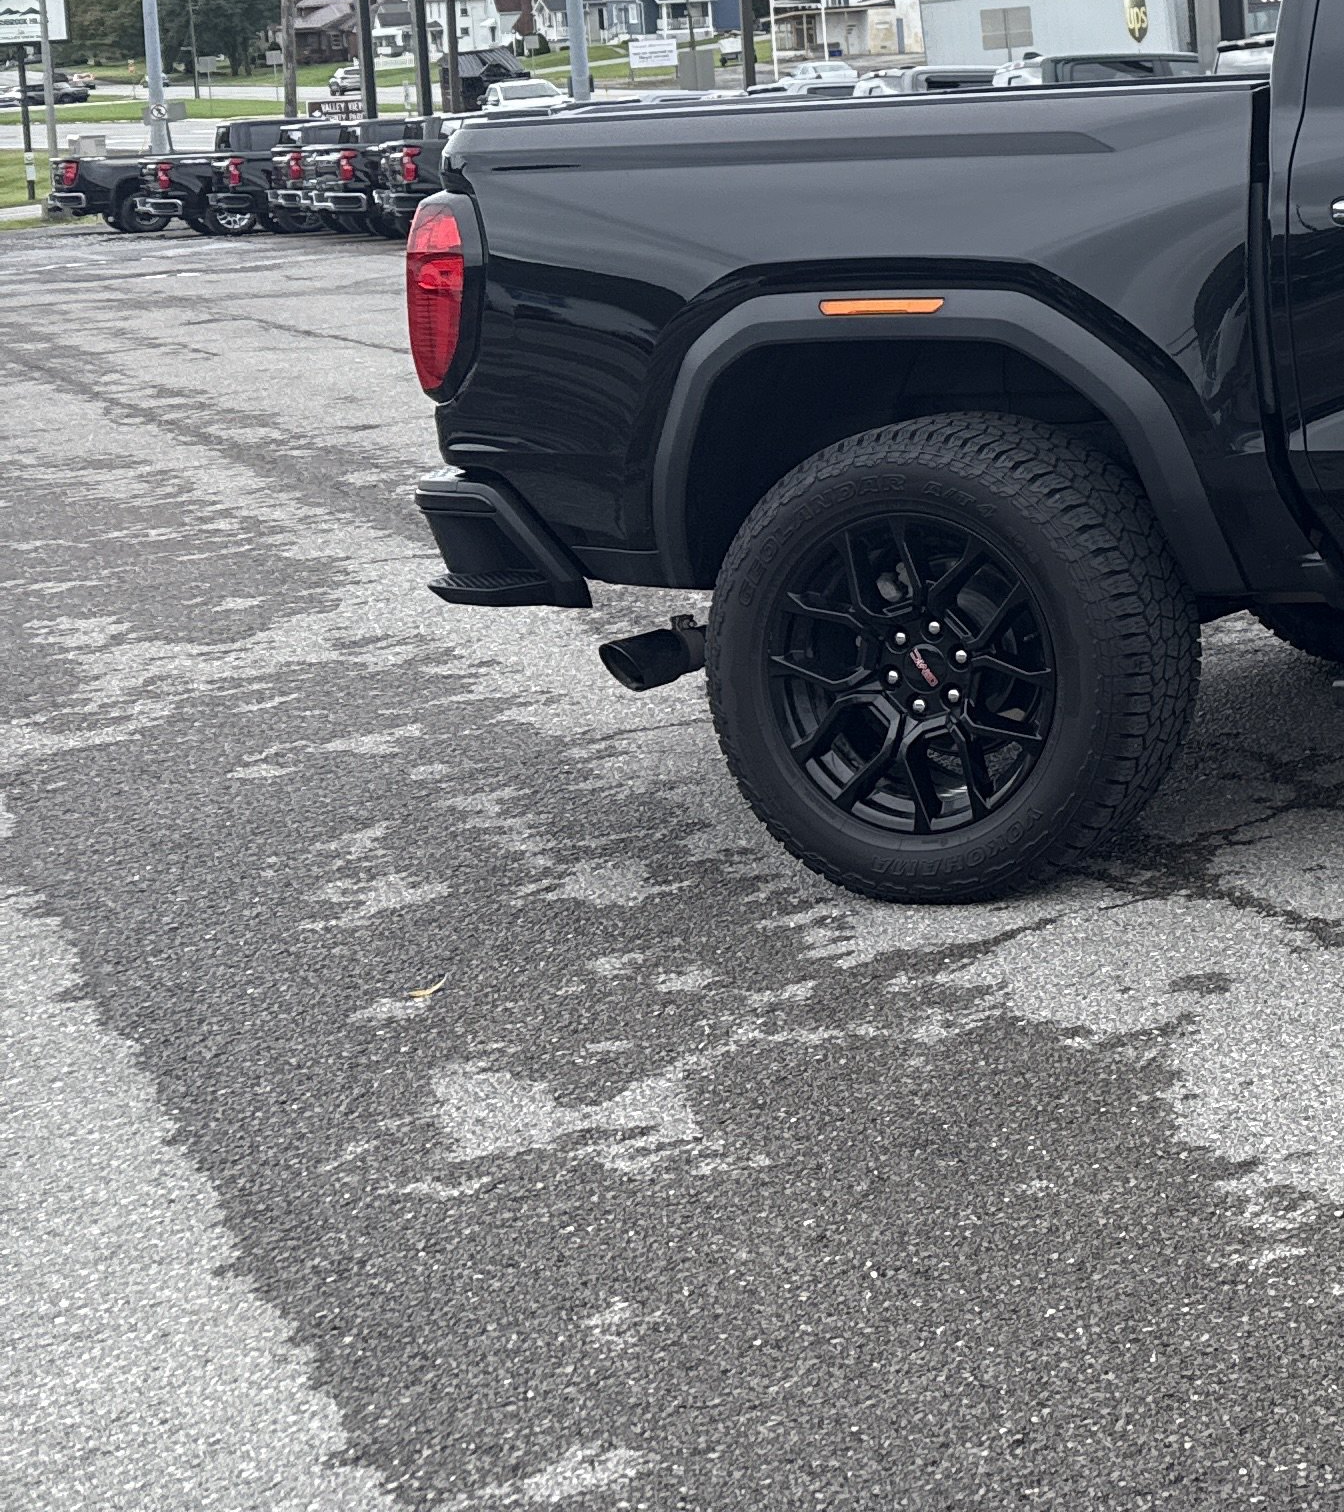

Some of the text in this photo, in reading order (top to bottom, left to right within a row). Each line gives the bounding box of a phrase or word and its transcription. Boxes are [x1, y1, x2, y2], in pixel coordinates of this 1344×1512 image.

[1128, 6, 1148, 37] ups
[321, 102, 345, 112] VALLEY
[740, 473, 906, 606] GEOLANDAR
[910, 648, 939, 687] GMC
[871, 807, 1043, 877] YOKOHAMA
